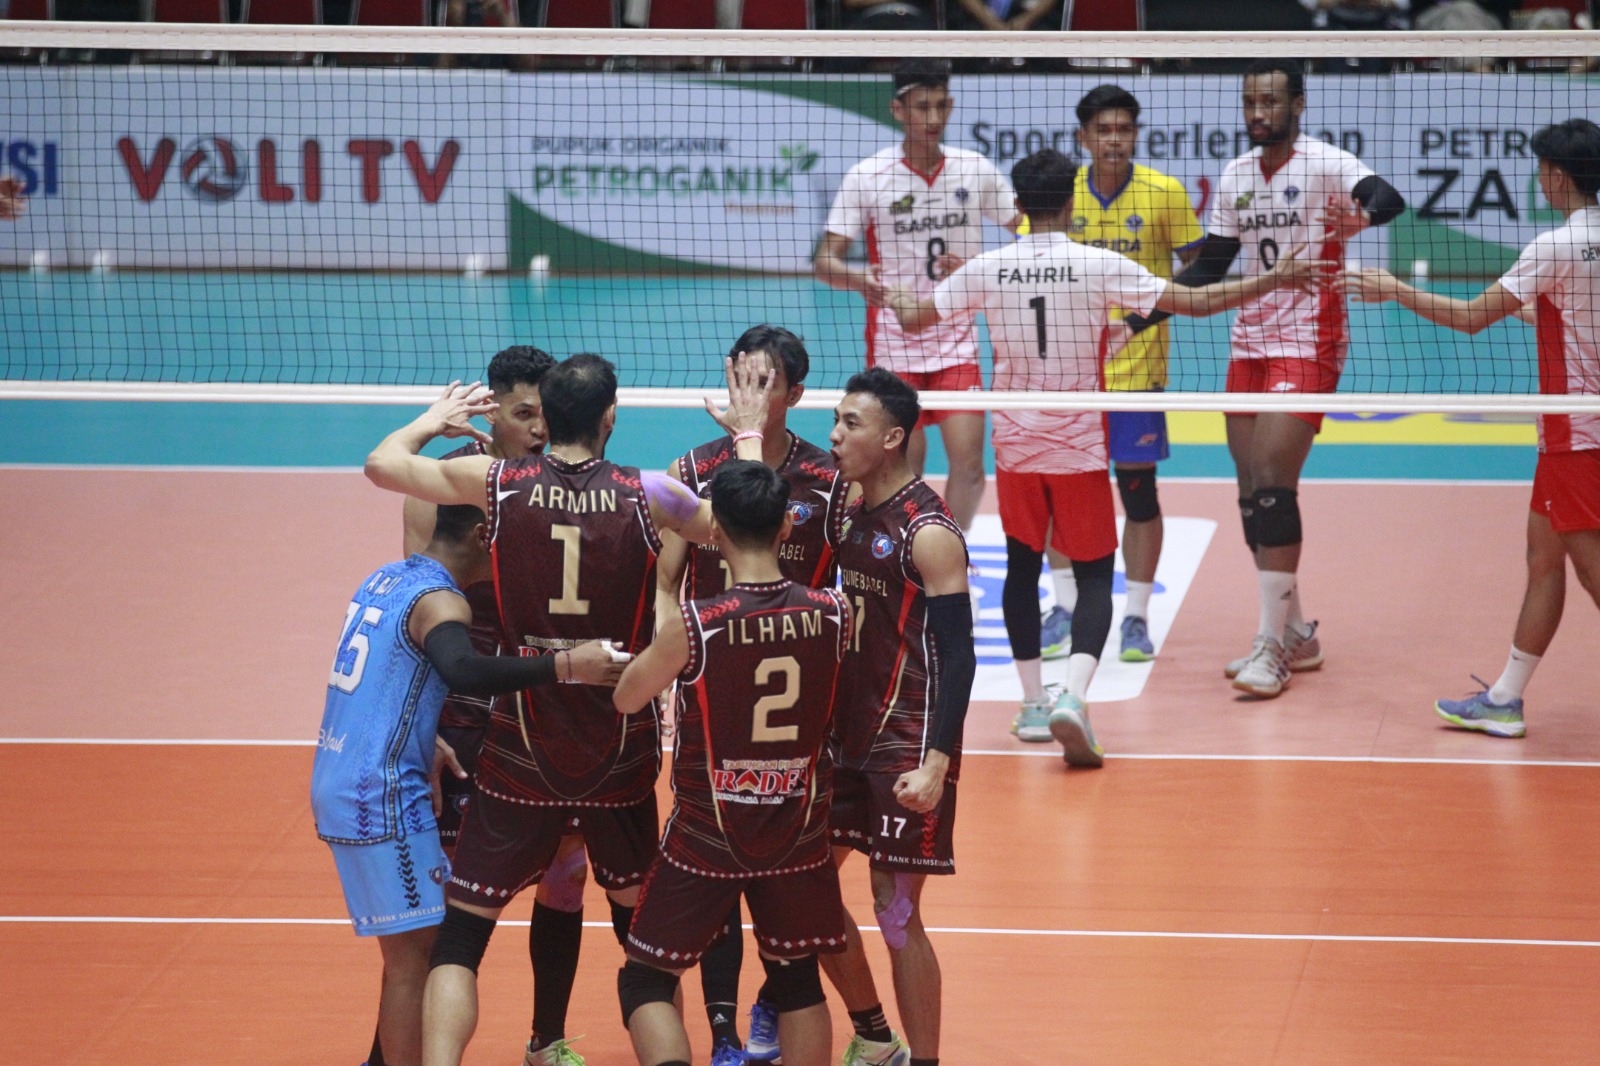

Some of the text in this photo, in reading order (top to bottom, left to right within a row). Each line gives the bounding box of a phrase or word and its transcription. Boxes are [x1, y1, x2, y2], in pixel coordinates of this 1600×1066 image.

[533, 137, 730, 153] PUPUK ORGANIK
[1421, 129, 1532, 157] PETR
[0, 141, 57, 195] SI
[117, 137, 460, 203] VOLI TV
[534, 165, 793, 197] PETROGANIK
[893, 213, 968, 234] GARUDA
[926, 237, 946, 281] 8
[1260, 238, 1279, 271] 0
[998, 266, 1079, 285] FAHRIL
[1029, 295, 1048, 360] 1
[528, 483, 617, 514] ARMIN
[548, 523, 590, 616] 1
[728, 609, 822, 645] ILHAM
[751, 655, 801, 743] 2
[880, 815, 907, 839] 17
[888, 855, 909, 864] BANK
[378, 914, 397, 923] BANK
